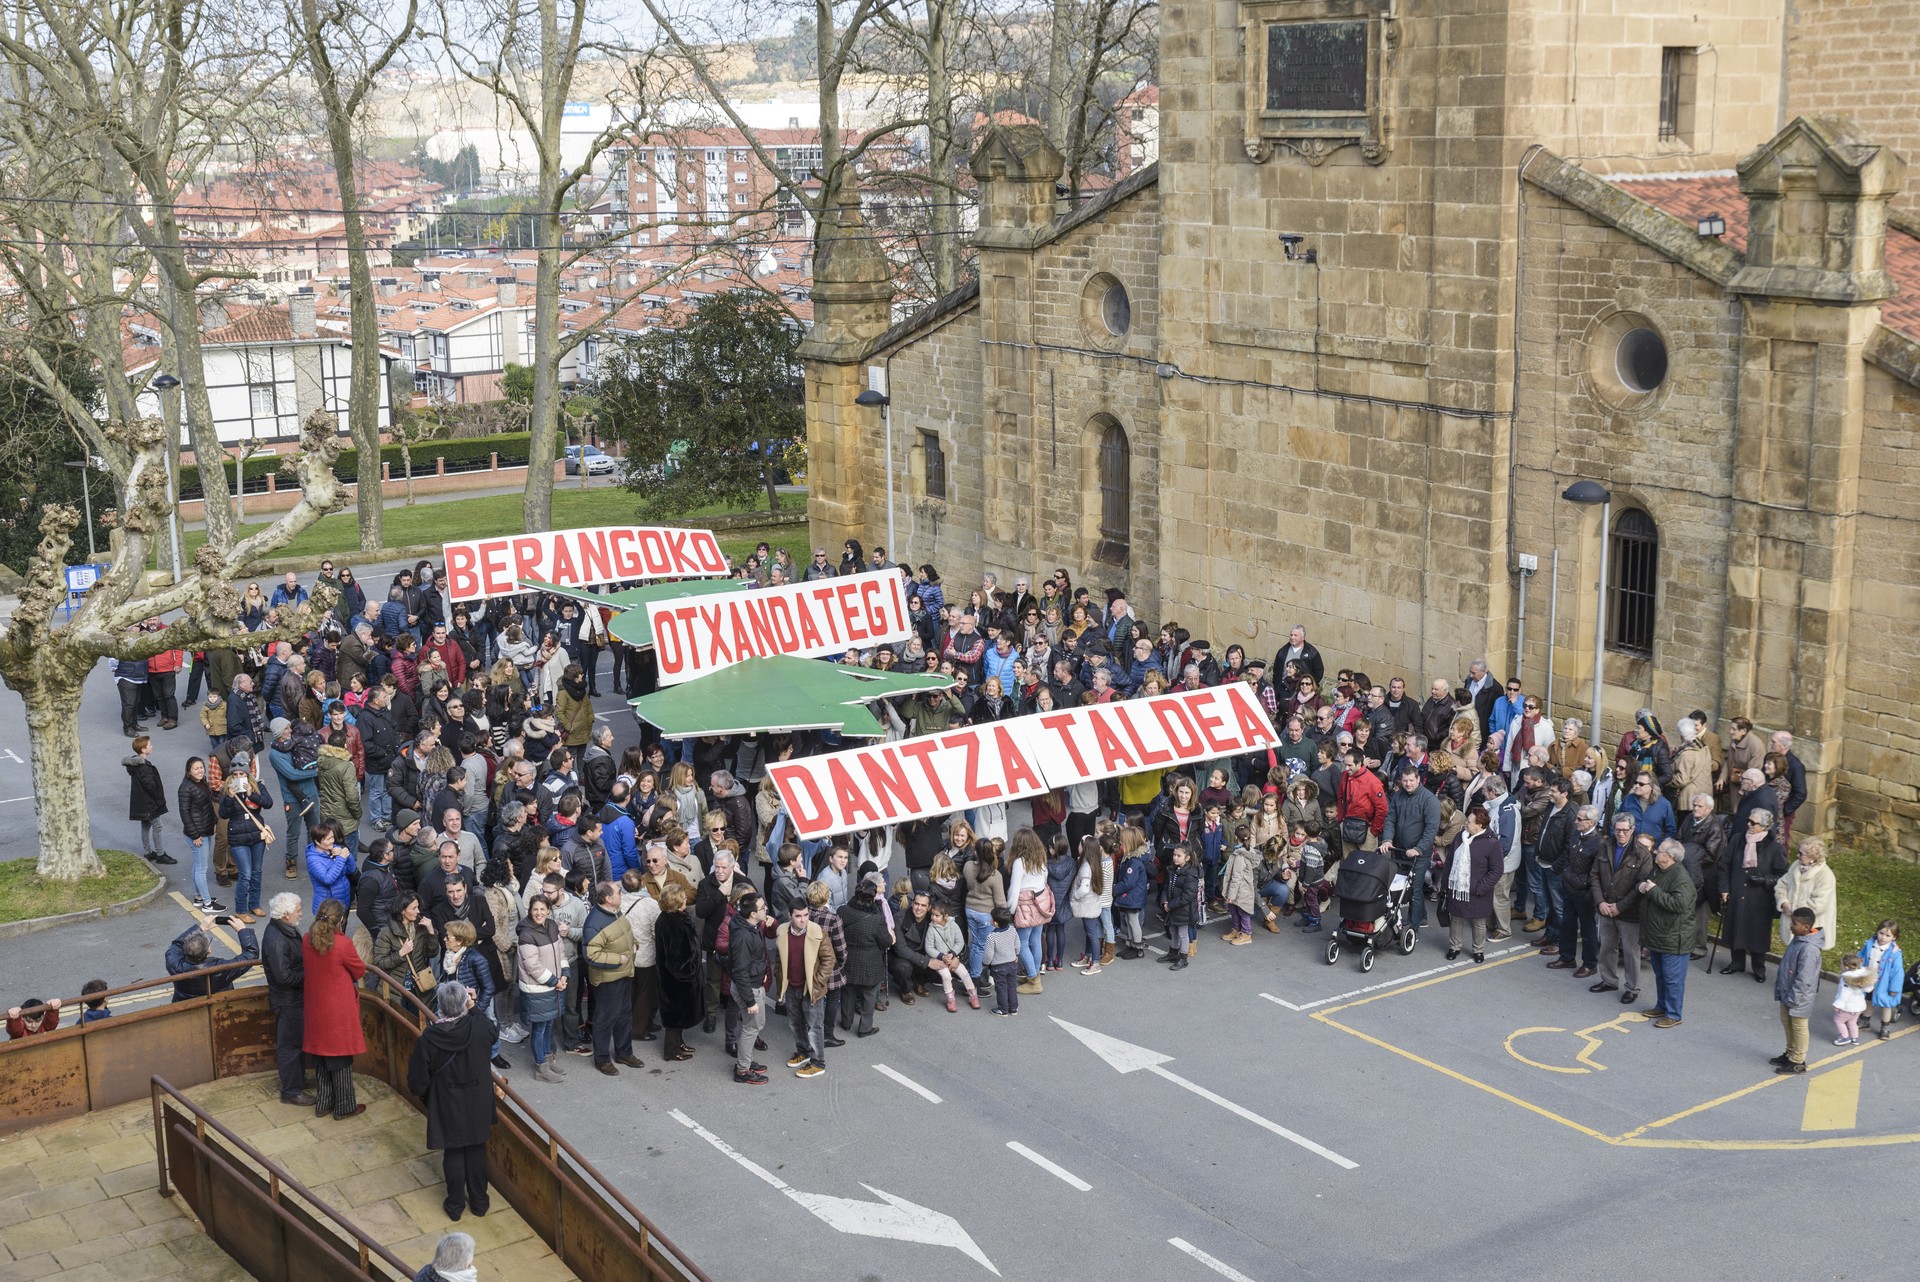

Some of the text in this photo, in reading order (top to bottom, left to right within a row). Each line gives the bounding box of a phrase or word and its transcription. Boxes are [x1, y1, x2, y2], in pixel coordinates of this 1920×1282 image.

[446, 530, 726, 598] BERANGOKO
[654, 578, 906, 674] OTXANDATEGI
[771, 688, 1275, 833] DANTZA TALDEA
